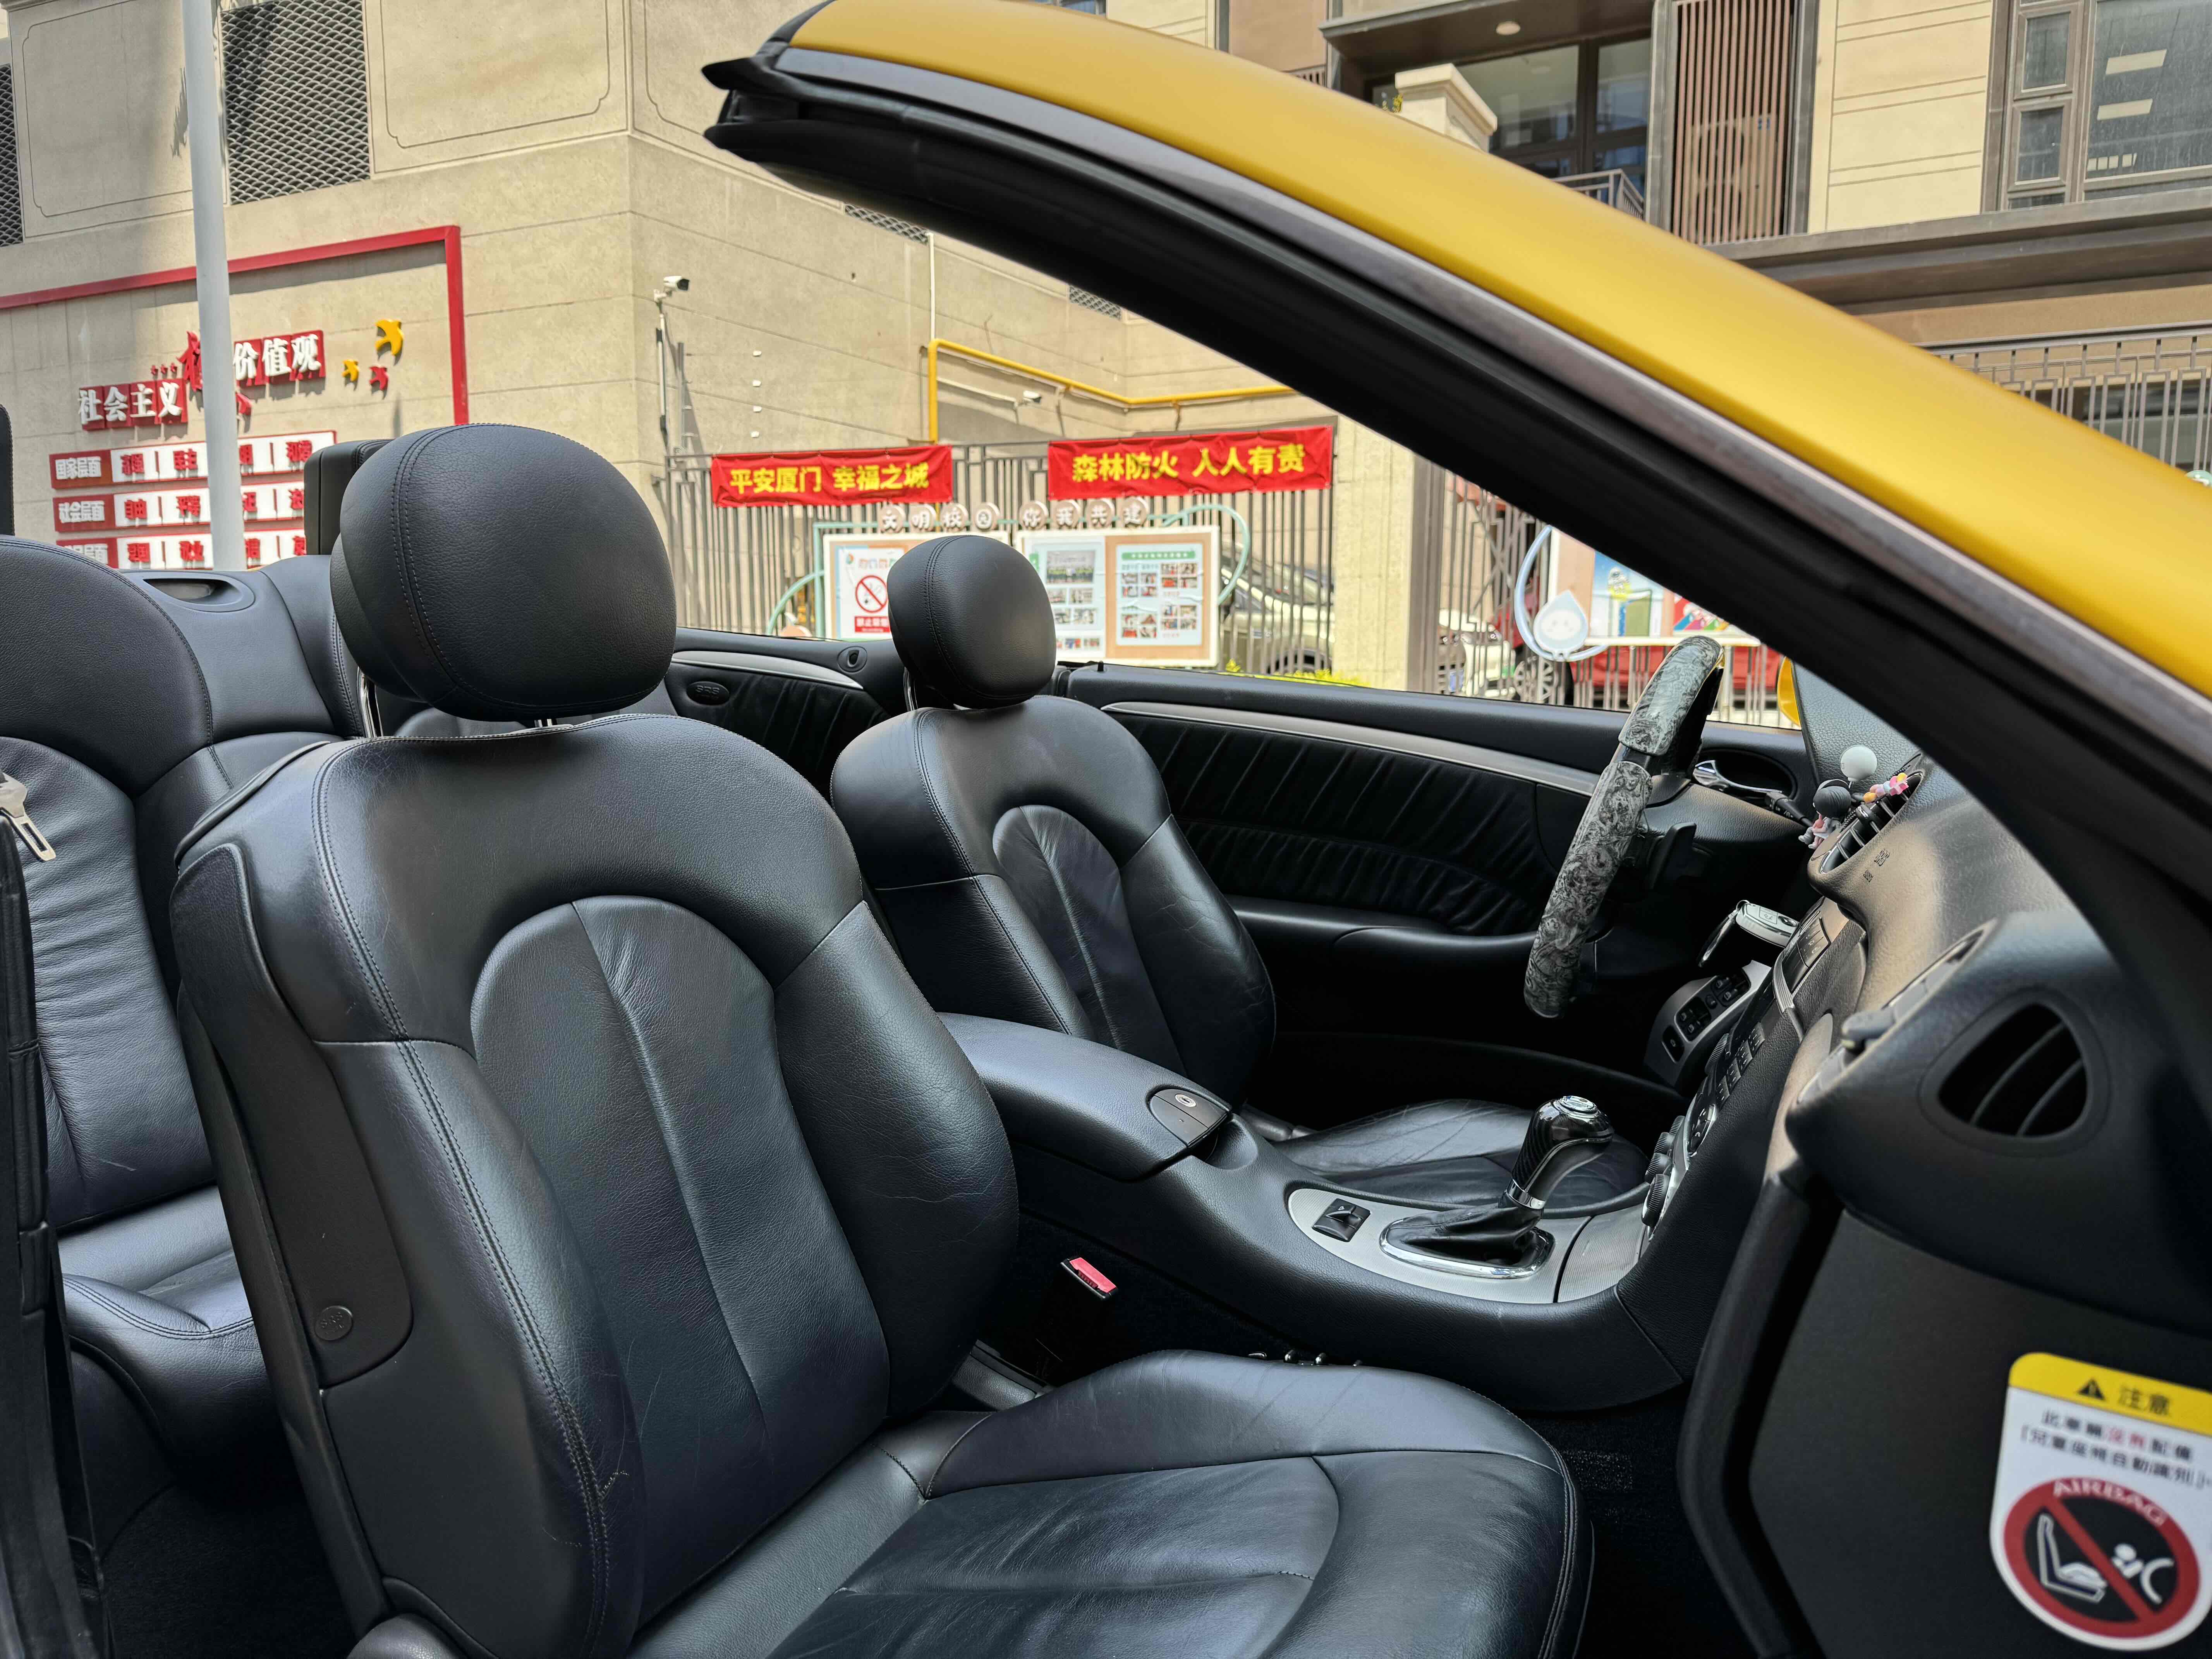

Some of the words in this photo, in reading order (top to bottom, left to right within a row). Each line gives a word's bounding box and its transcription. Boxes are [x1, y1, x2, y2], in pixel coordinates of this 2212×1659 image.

[78, 382, 182, 425] 社会主义
[55, 456, 101, 480] 国家层面
[173, 448, 198, 471] 民主
[730, 466, 822, 494] 平安厦门
[833, 462, 929, 492] 幸福之城
[1072, 450, 1178, 482] 森林防火
[1192, 443, 1306, 477] 人人有责
[59, 500, 105, 524] 社会层面
[124, 498, 147, 520] 自由
[176, 495, 201, 517] 平等
[127, 543, 150, 563] 爱国
[2118, 1385, 2170, 1416] 注意
[2054, 1479, 2168, 1527] AIRBAG
